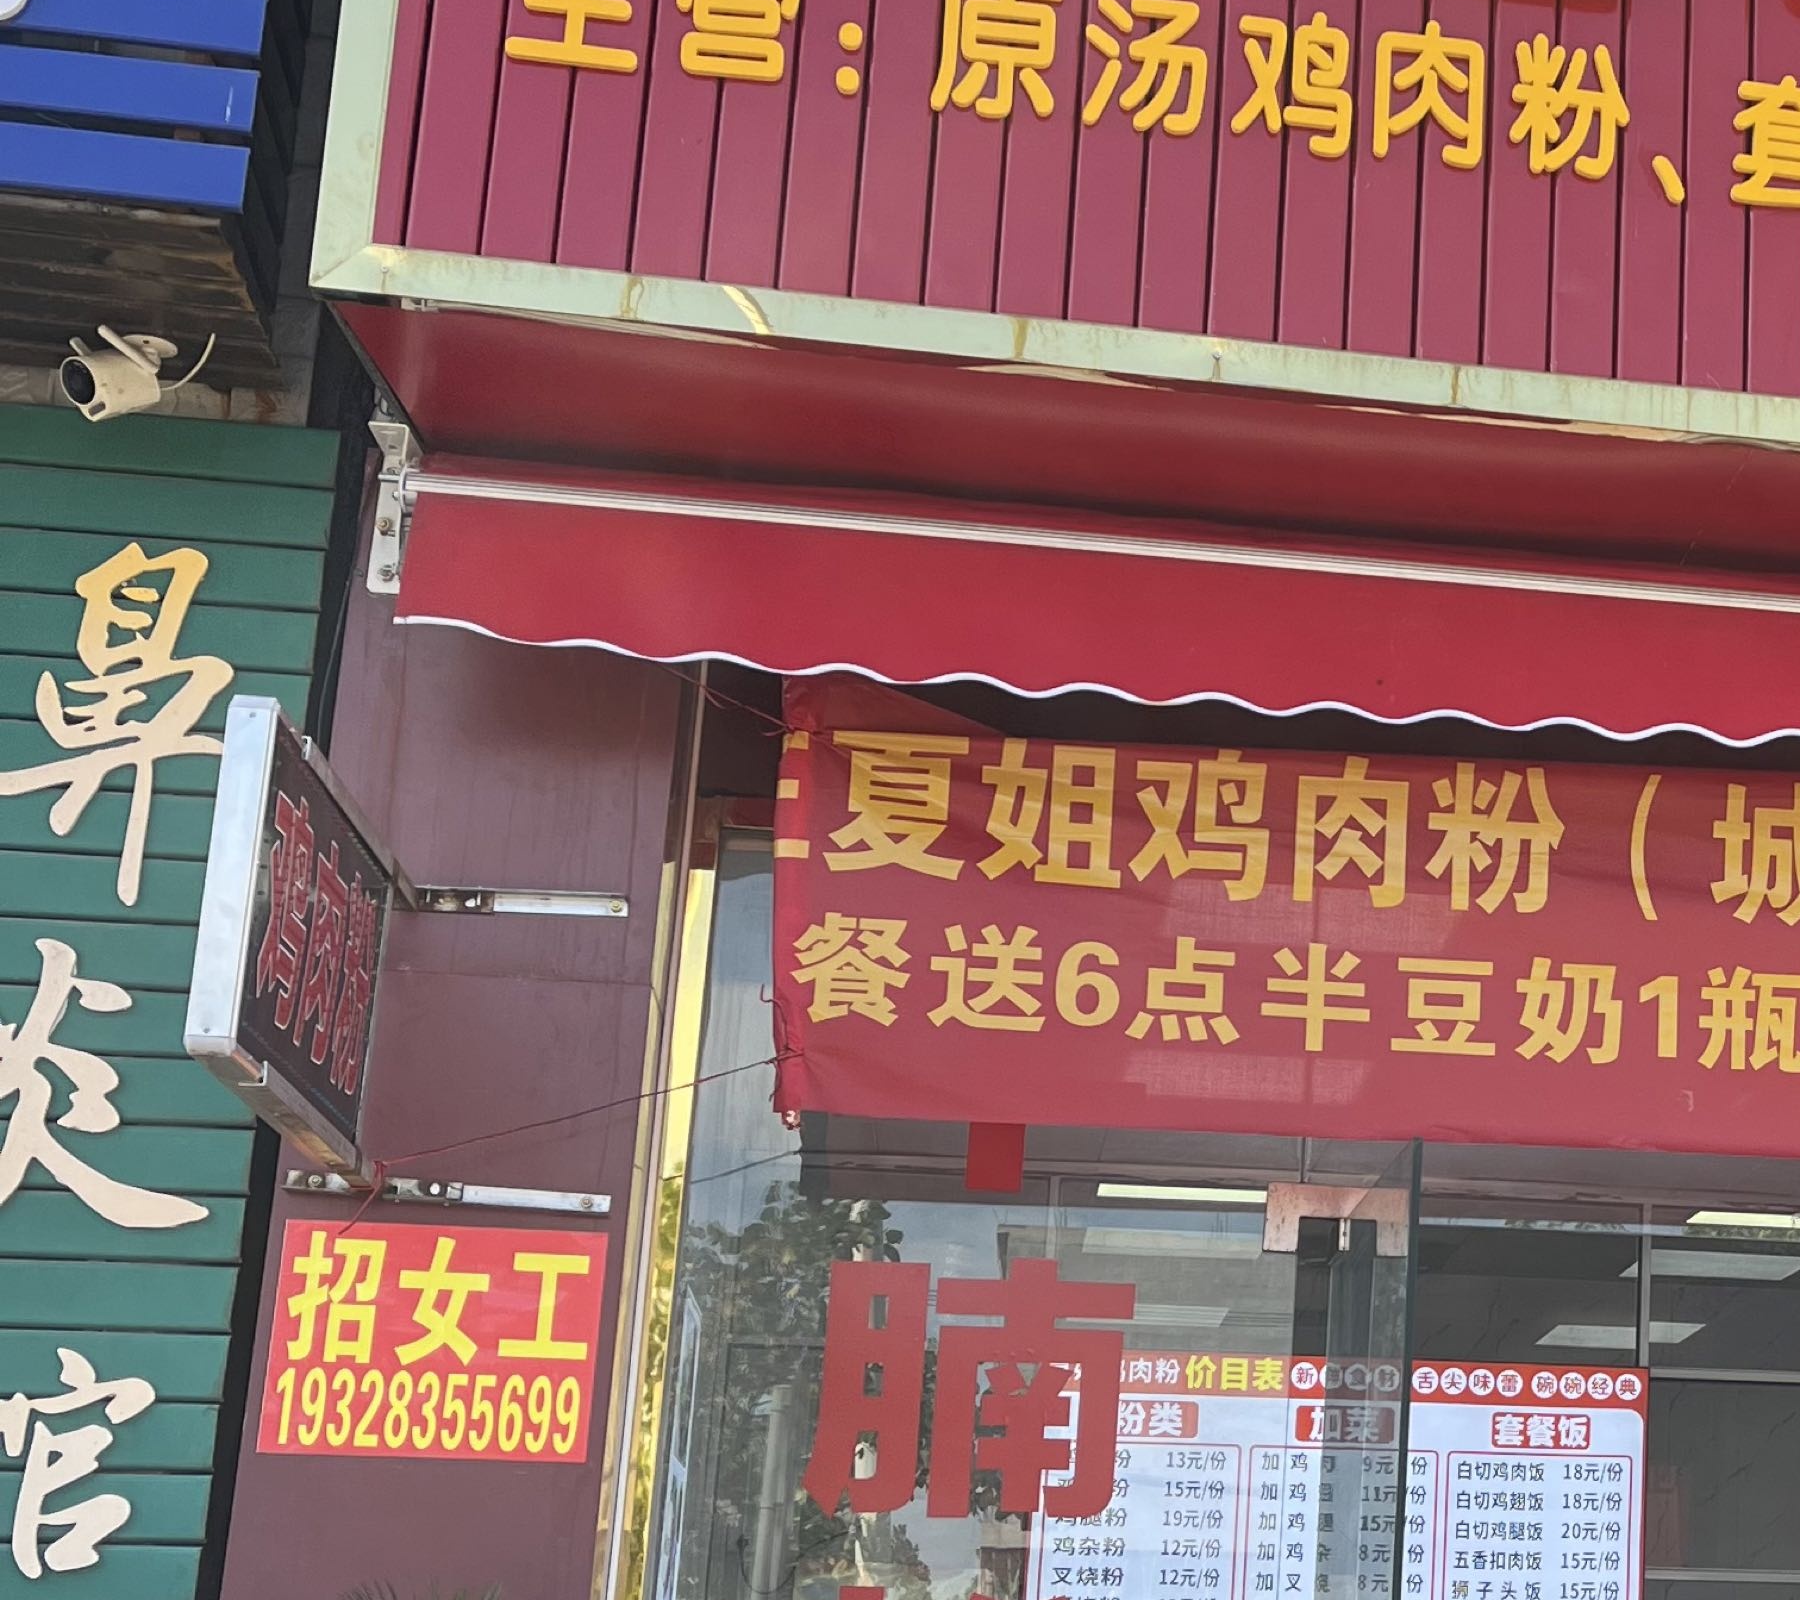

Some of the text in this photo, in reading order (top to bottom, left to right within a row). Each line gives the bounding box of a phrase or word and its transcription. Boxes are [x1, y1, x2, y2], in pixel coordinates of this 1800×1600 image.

[285, 1229, 589, 1366] 招女工
[275, 1366, 581, 1457] 19328355699
[1494, 1413, 1590, 1448] 套餐饭
[1166, 1450, 1227, 1473] 13元/份
[1457, 1460, 1624, 1483] 白切鸡肉饭 18元/份
[1164, 1478, 1225, 1500] 15元/份
[1456, 1490, 1623, 1513] 白切鸡翅饭 18元/份
[1162, 1508, 1224, 1530] 19元/份
[1455, 1520, 1622, 1543] 白切鸡腿饭 20元/份
[1053, 1537, 1222, 1560] 鸡杂粉 12元/份
[1453, 1550, 1621, 1573] 五香扣肉饭 15元/份
[1051, 1567, 1221, 1589] 叉烧粉 12元/份
